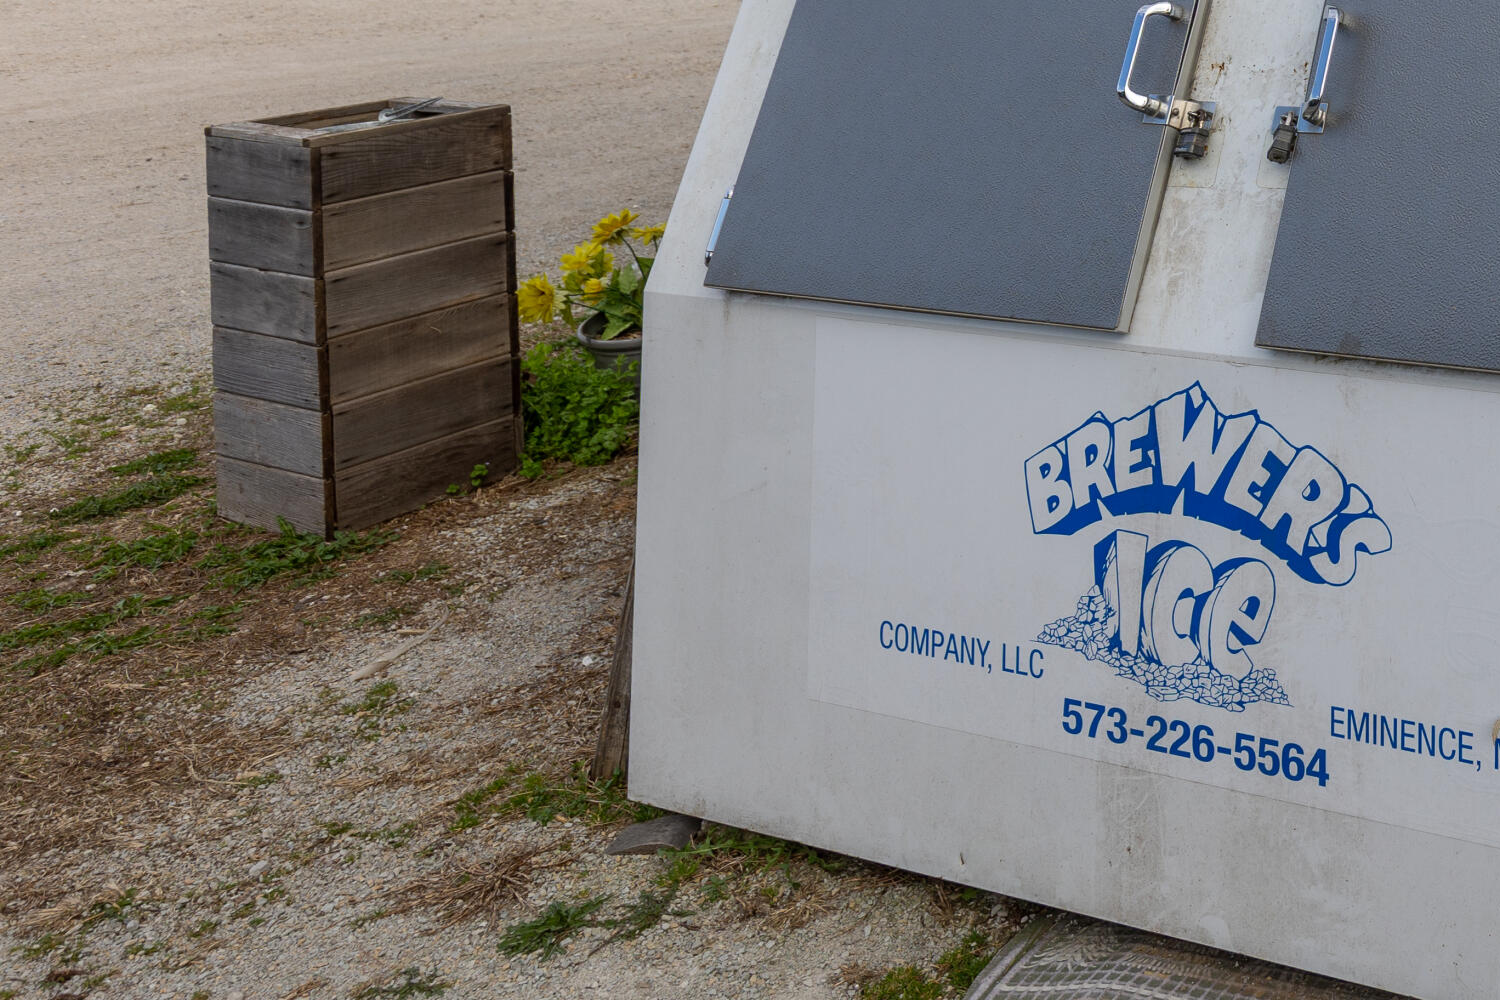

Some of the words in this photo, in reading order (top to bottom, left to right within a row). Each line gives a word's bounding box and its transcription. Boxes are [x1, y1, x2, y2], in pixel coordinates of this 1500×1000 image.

[1024, 381, 1392, 586] BREWER'S
[879, 620, 992, 674] COMPANY,
[1001, 642, 1044, 679] LLC
[1061, 697, 1330, 787] 573-226-5564
[1330, 706, 1482, 772] EMINENCE,
